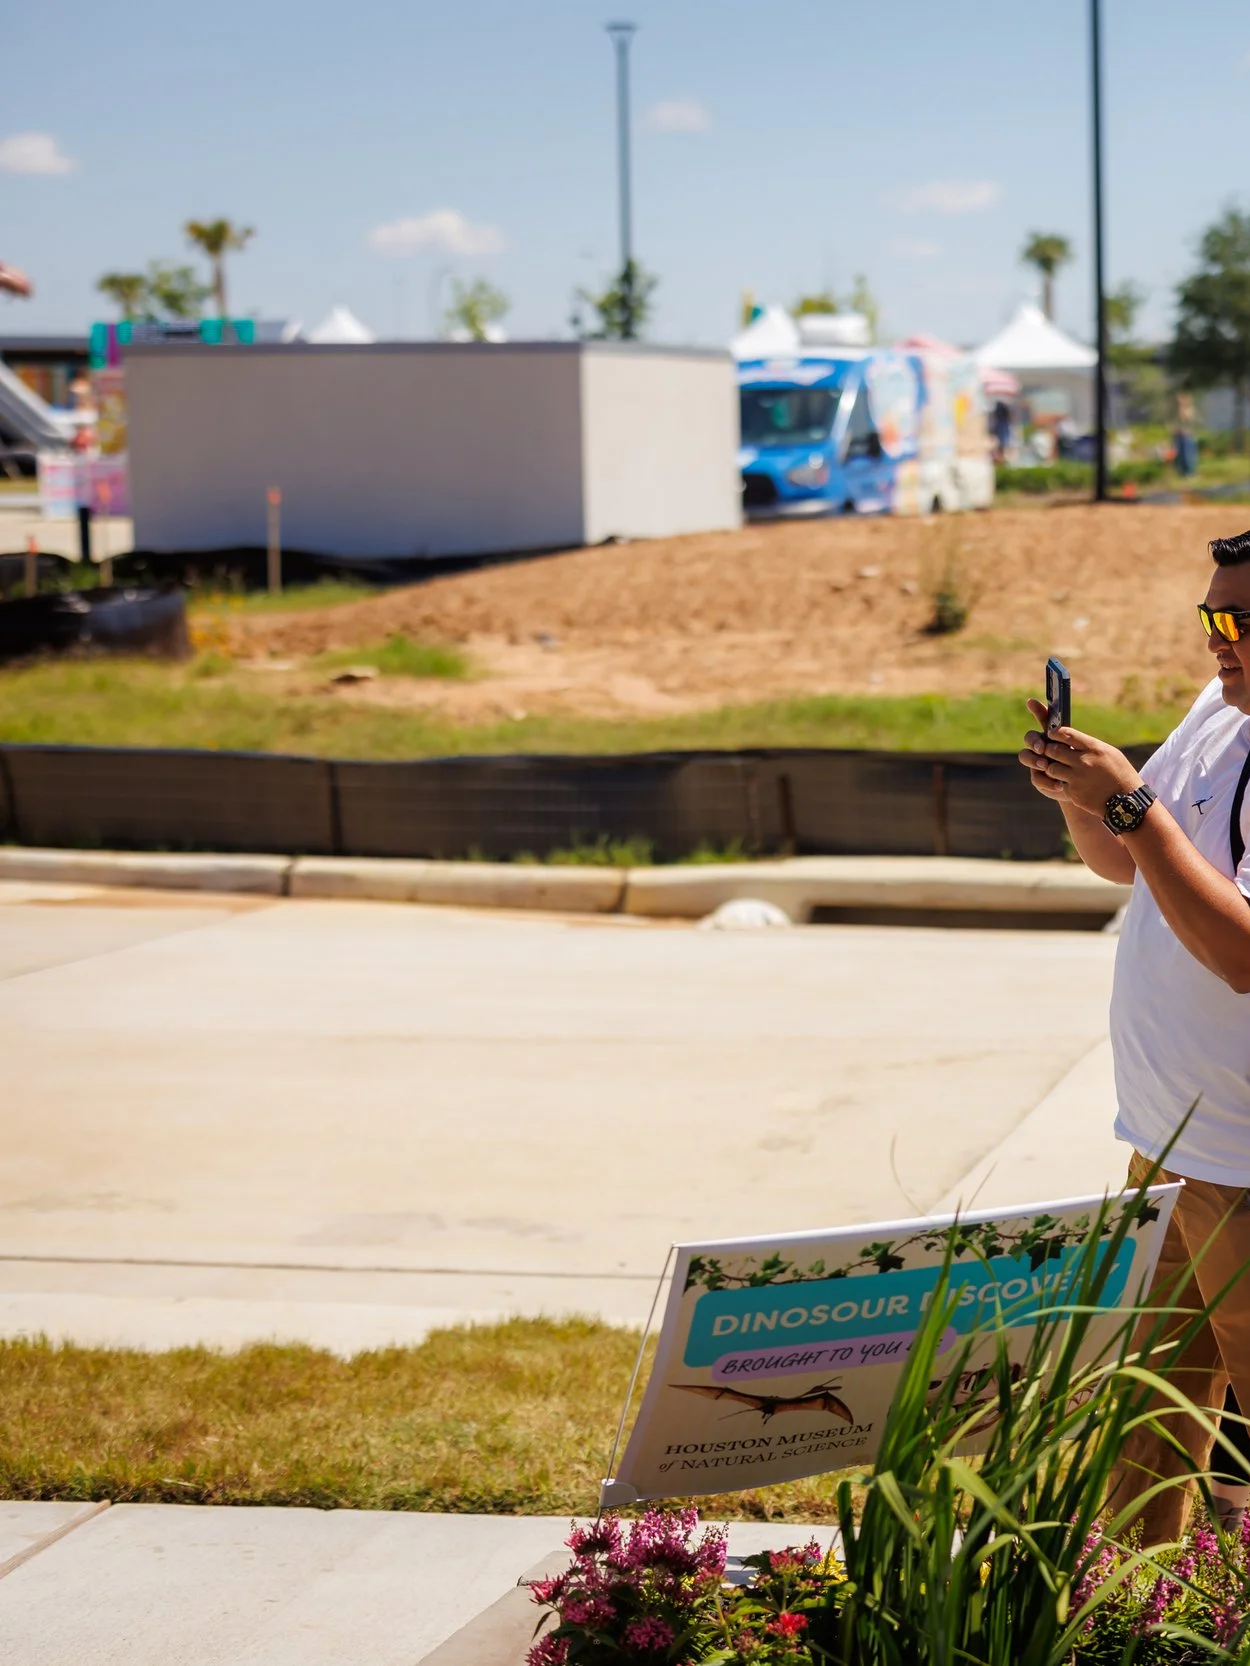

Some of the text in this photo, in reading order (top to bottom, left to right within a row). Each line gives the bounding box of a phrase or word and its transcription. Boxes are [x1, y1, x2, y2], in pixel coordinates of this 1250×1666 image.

[712, 1262, 1120, 1337] DINOSOUR ISCOVE
[721, 1349, 830, 1375] BROUGHT
[828, 1346, 853, 1363] TO
[859, 1340, 904, 1364] YOU
[658, 1435, 869, 1473] of NATURAL SCIENCE
[664, 1422, 875, 1456] HOUSTON MUSEUM
